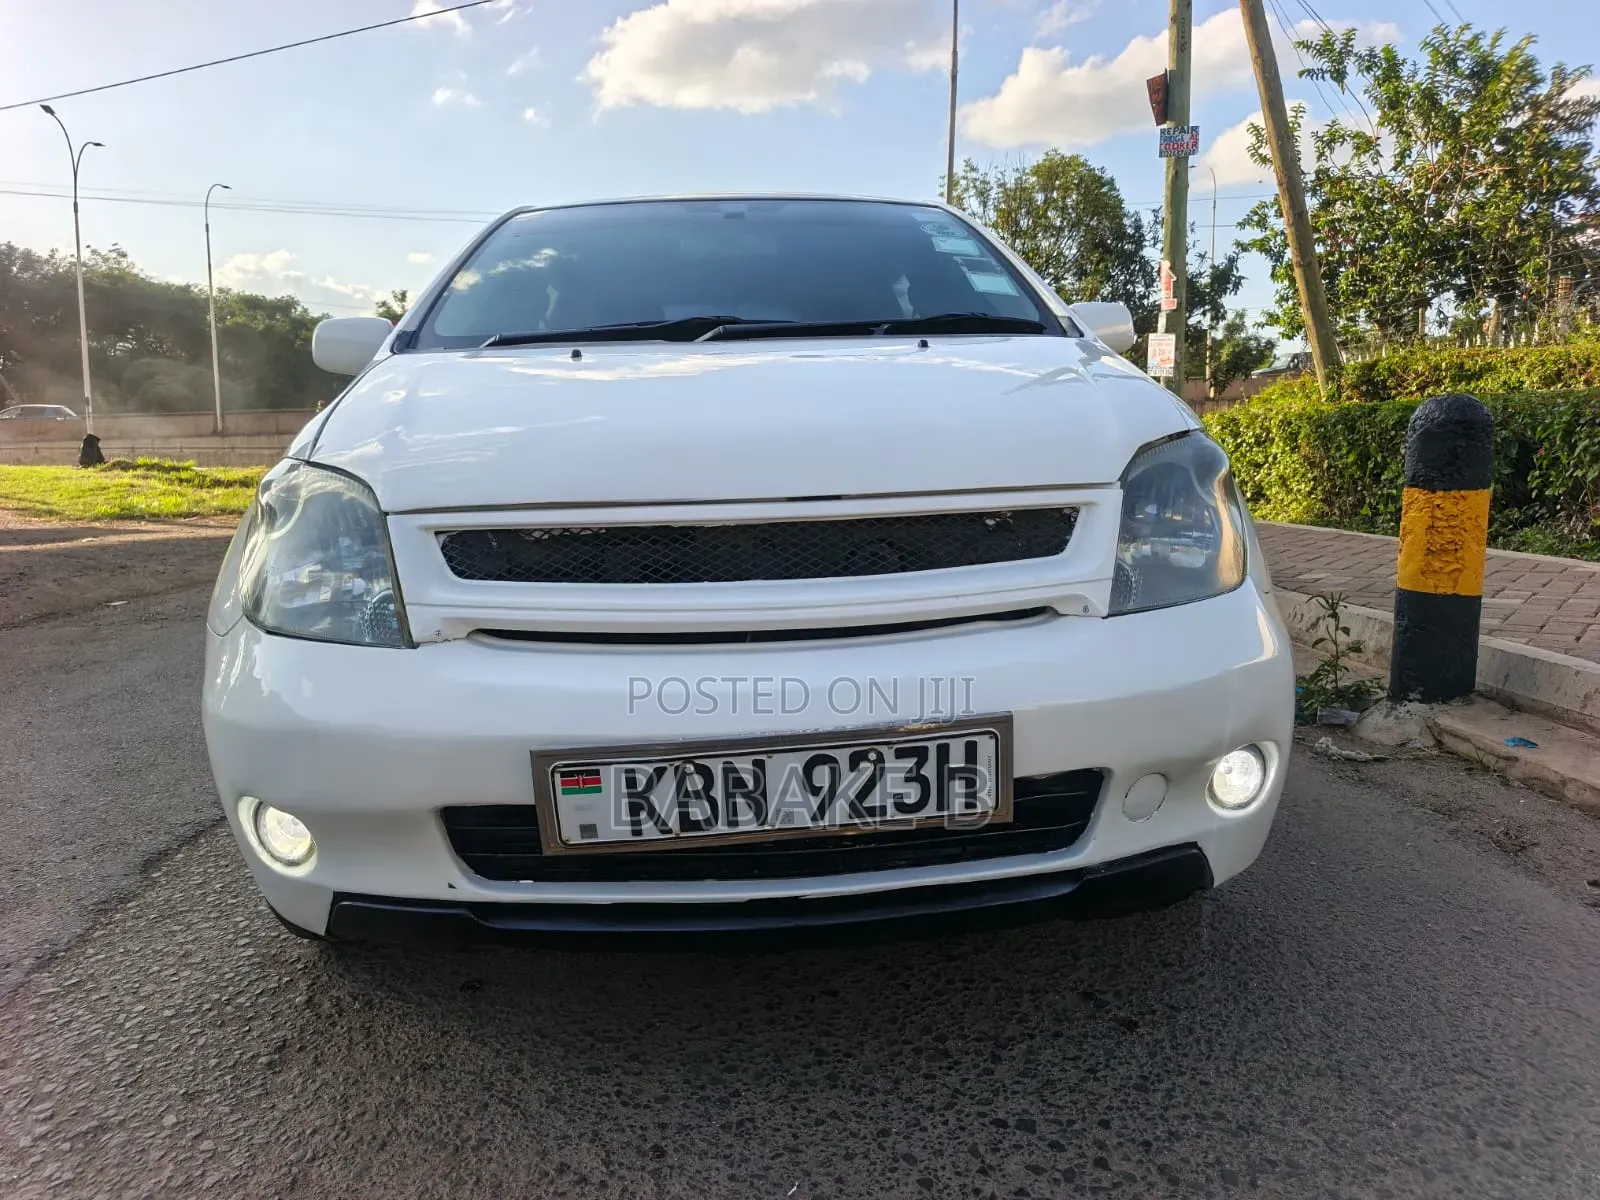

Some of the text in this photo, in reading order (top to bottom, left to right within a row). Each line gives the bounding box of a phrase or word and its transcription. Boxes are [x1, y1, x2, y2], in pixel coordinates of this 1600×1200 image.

[1160, 126, 1199, 135] REPAIR
[624, 757, 769, 837] KBN
[802, 739, 978, 823] 923H
